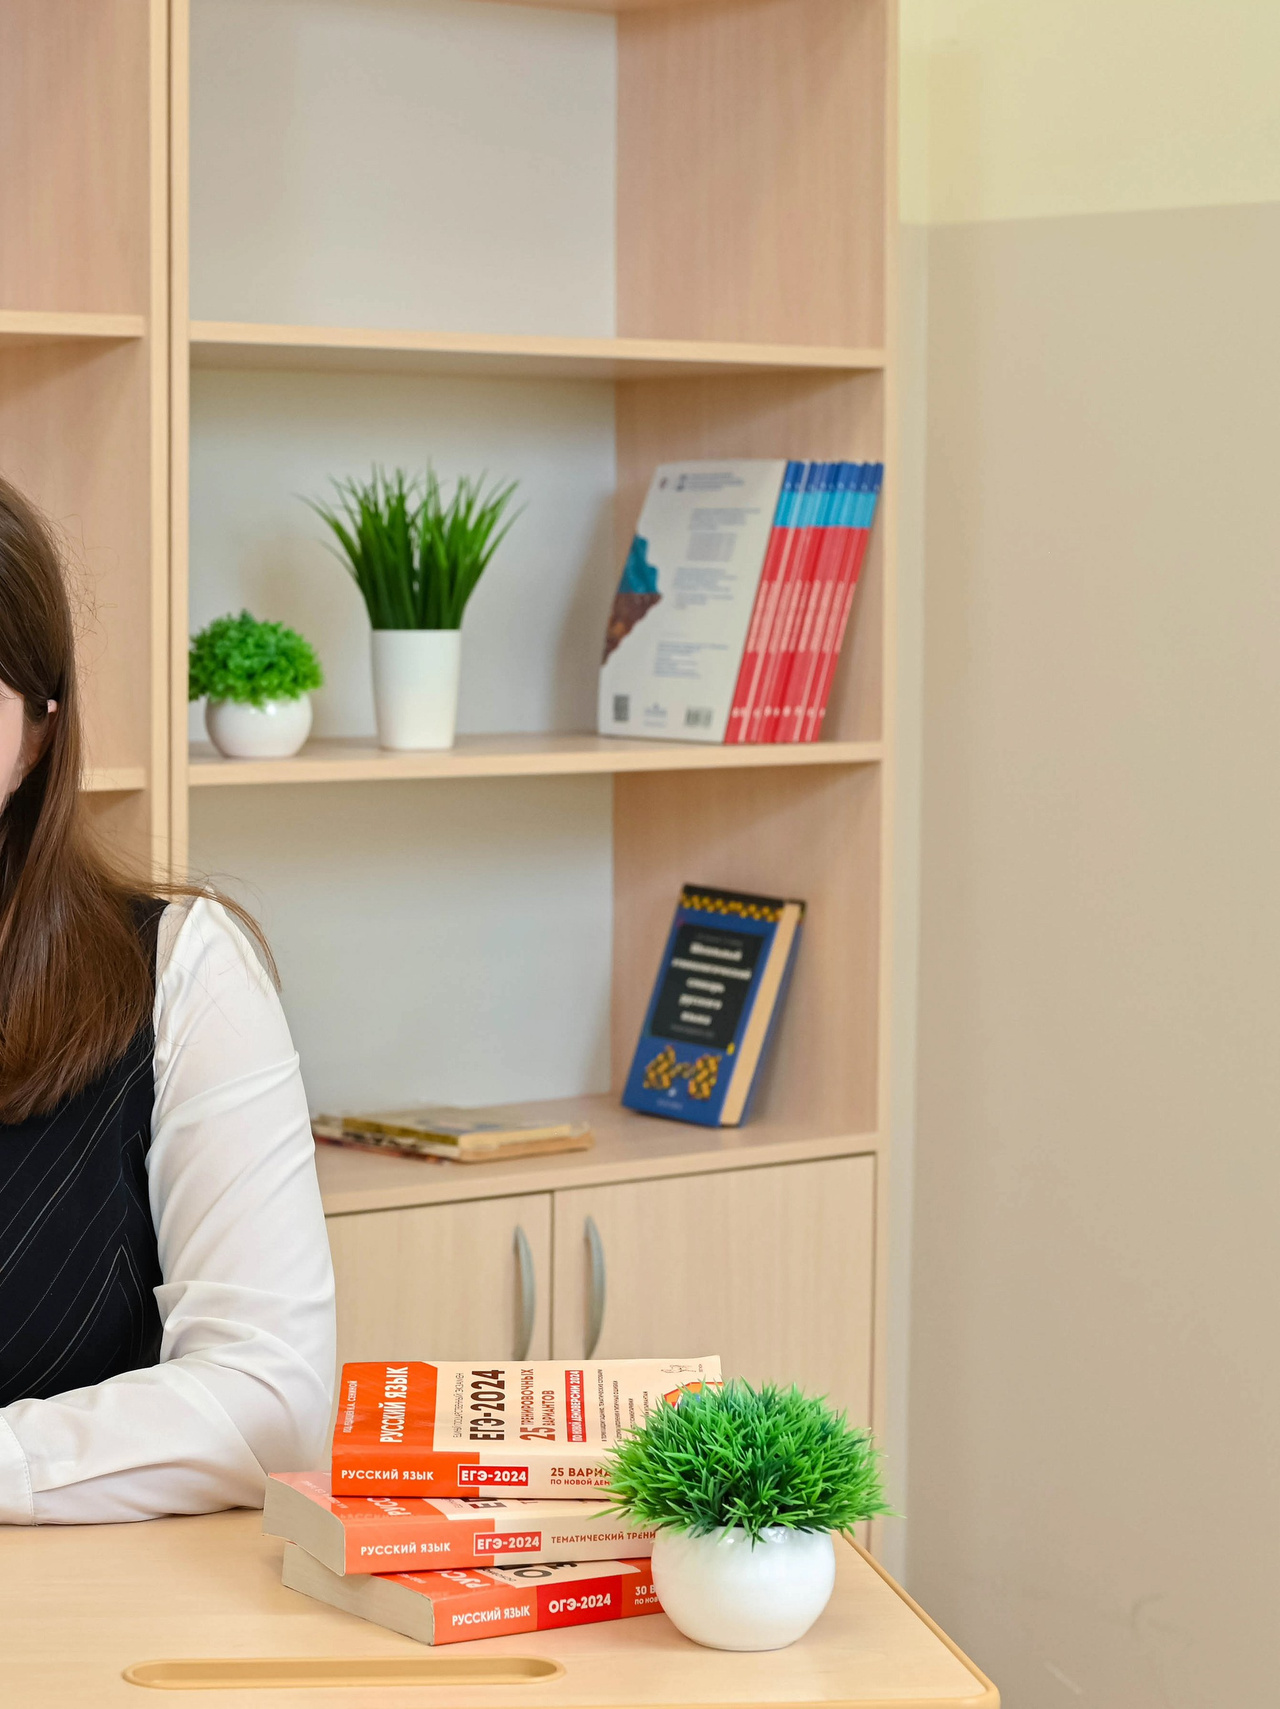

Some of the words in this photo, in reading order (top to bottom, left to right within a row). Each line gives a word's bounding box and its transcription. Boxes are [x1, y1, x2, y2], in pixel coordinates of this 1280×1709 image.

[384, 1366, 408, 1399] ЯЗЫК
[569, 1370, 581, 1385] 2024
[520, 1369, 535, 1425] ТРЕНИРОВОЧНЫХ
[570, 1385, 583, 1421] ДЕМОВЕРСИИ
[469, 1370, 506, 1441] ЕГЭ-2024
[541, 1390, 556, 1426] ВАРИАНТОВ
[378, 1402, 407, 1443] РУССКИЙ
[519, 1426, 556, 1442] 25
[341, 1469, 398, 1481] РУССКИЙ
[401, 1469, 435, 1481] ЯЗЫК
[462, 1469, 527, 1483] ЕГЭ-2024
[550, 1467, 564, 1477] 25
[564, 1478, 592, 1486] НОВОЙ
[476, 1535, 540, 1551] ЕГЭ-2024
[551, 1531, 624, 1544] ТЕМАТИЧЕСКИЙ
[360, 1542, 417, 1556] РУССКИЙ
[420, 1542, 451, 1553] ЯЗЫК
[635, 1585, 647, 1596] 30
[548, 1593, 612, 1614] ОГЭ-2024
[452, 1606, 502, 1627] РУССКИЙ
[503, 1605, 531, 1620] ЯЗЫК
